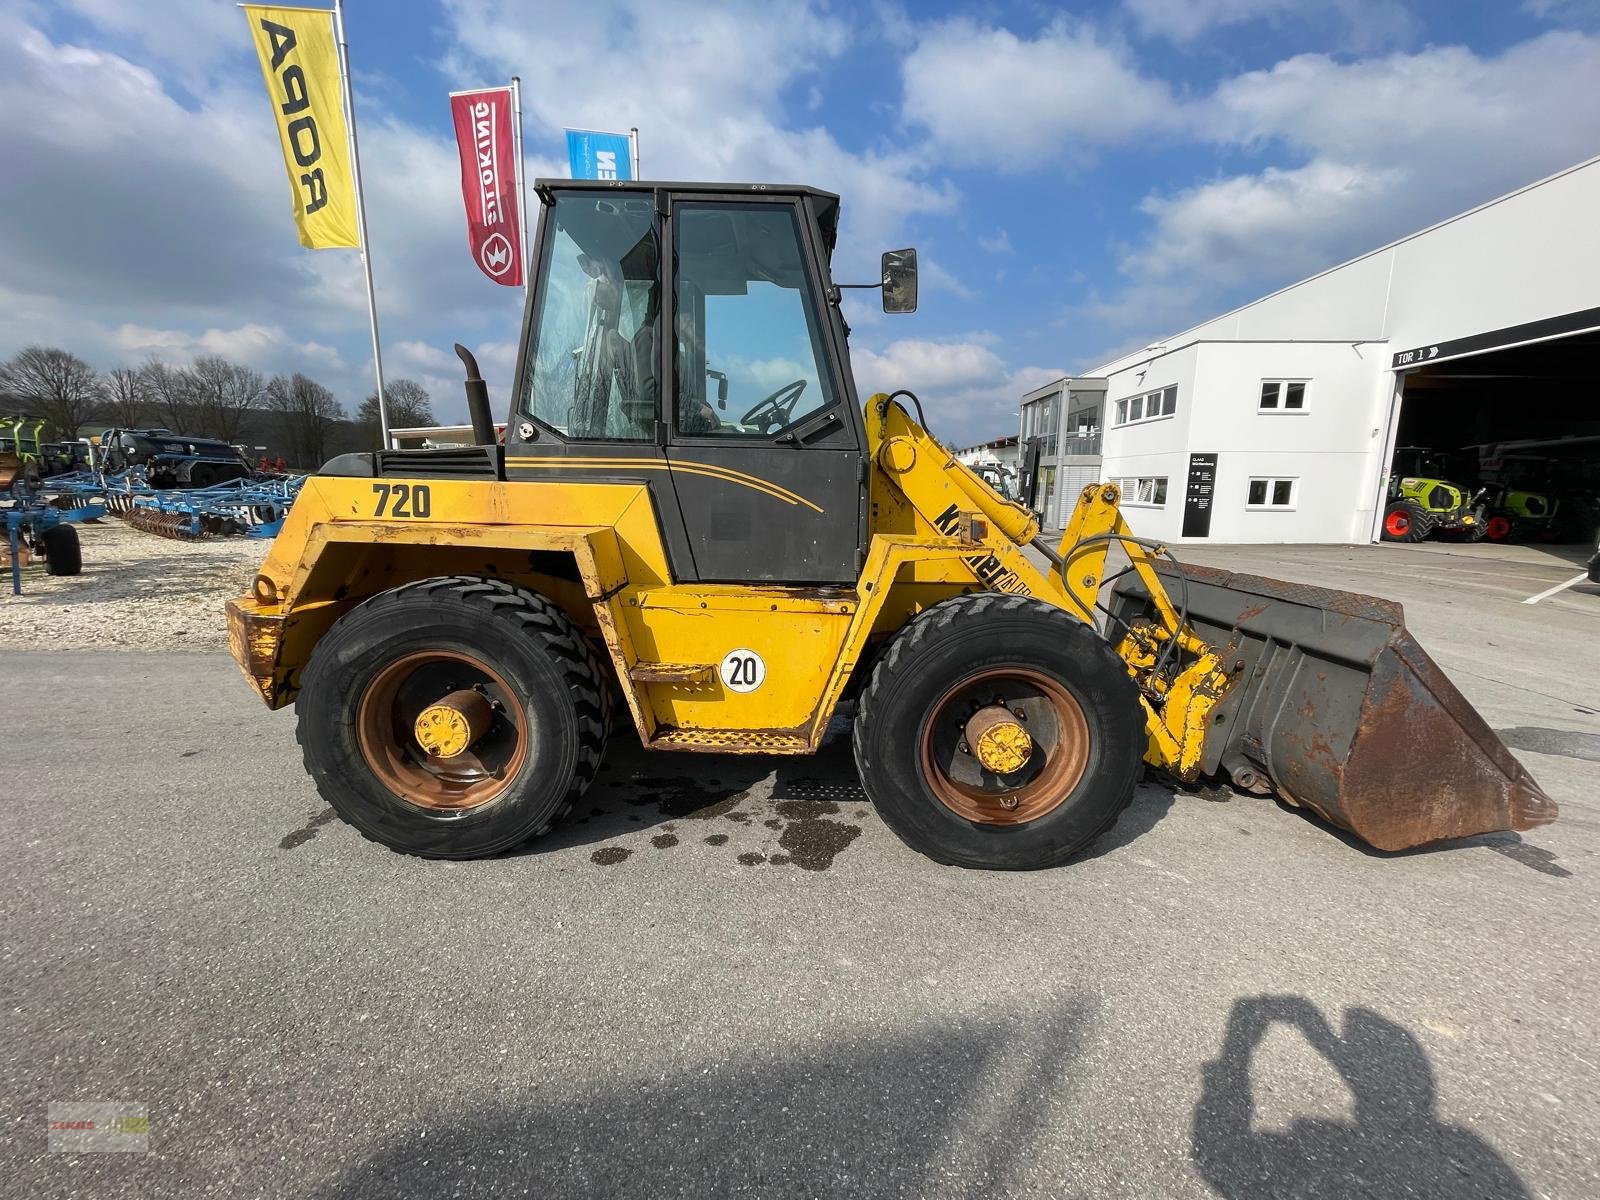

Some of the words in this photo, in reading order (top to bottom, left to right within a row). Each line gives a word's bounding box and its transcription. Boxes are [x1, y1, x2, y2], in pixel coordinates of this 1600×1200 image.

[1398, 351, 1414, 365] TOR
[1417, 349, 1424, 361] 1
[372, 483, 431, 518] 720
[729, 656, 757, 686] 20
